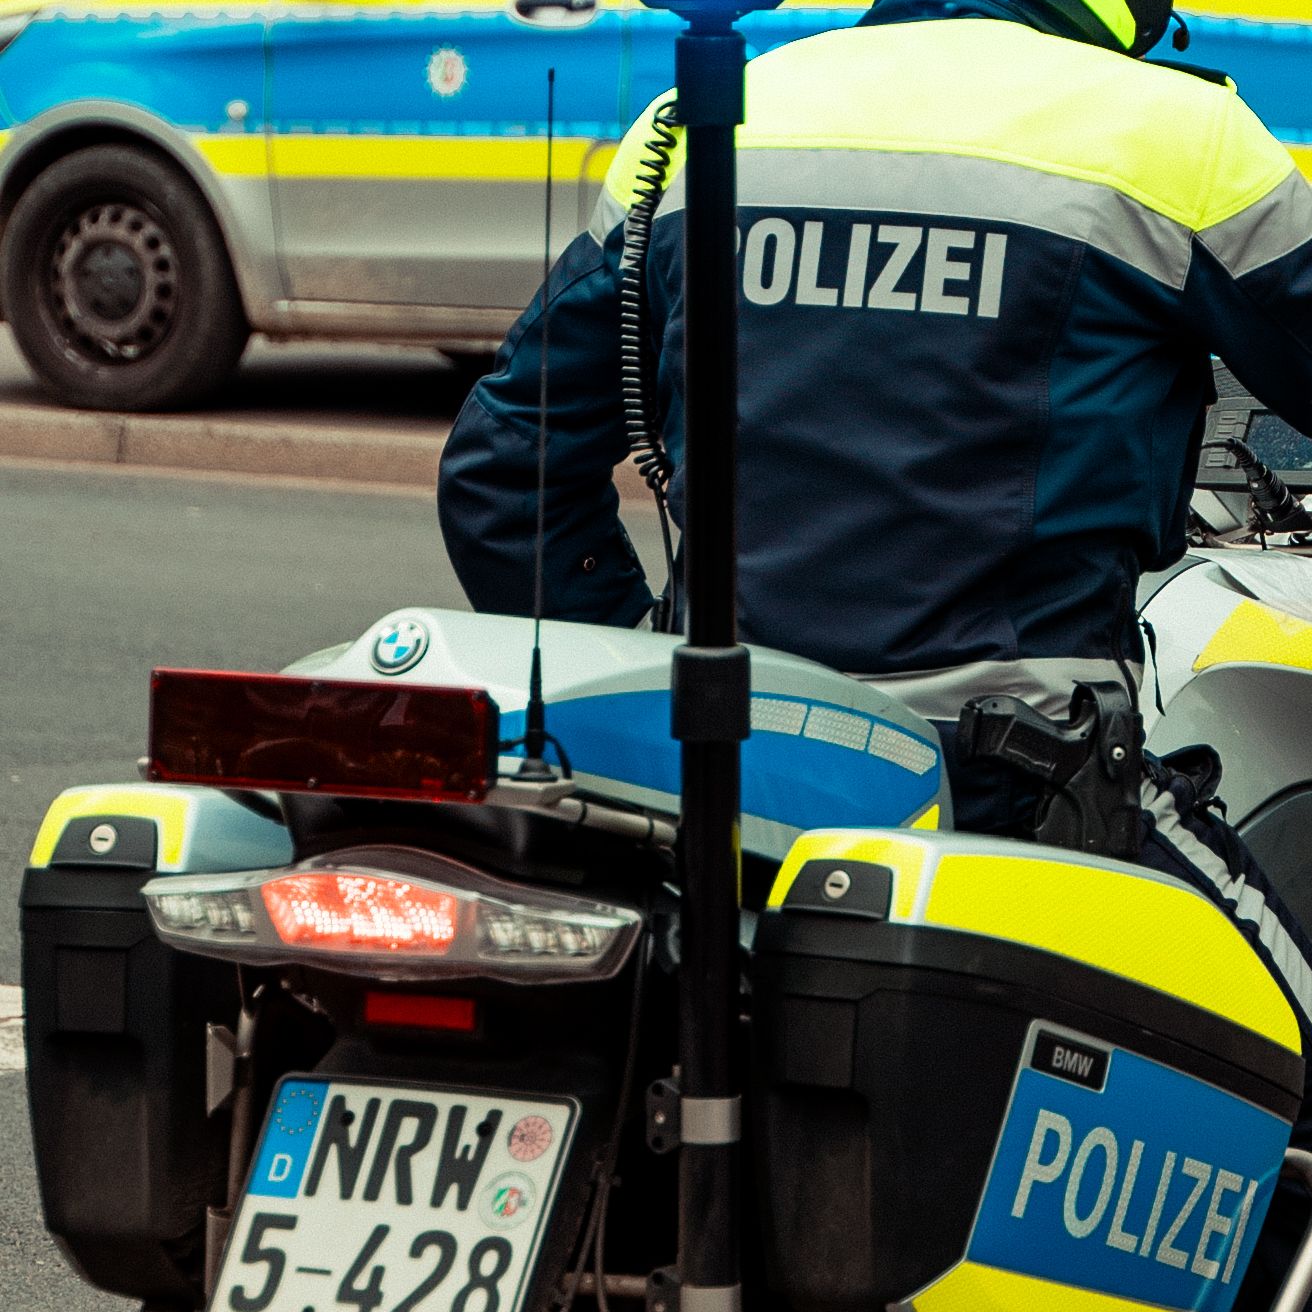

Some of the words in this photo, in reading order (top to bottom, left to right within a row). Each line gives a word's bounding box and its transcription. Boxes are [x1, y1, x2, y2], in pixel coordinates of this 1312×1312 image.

[736, 217, 1008, 318] OLIZEI
[1052, 1046, 1094, 1078] BMW
[267, 1154, 293, 1182] D
[304, 1094, 503, 1211] NRW
[1011, 1109, 1259, 1285] POLIZEI
